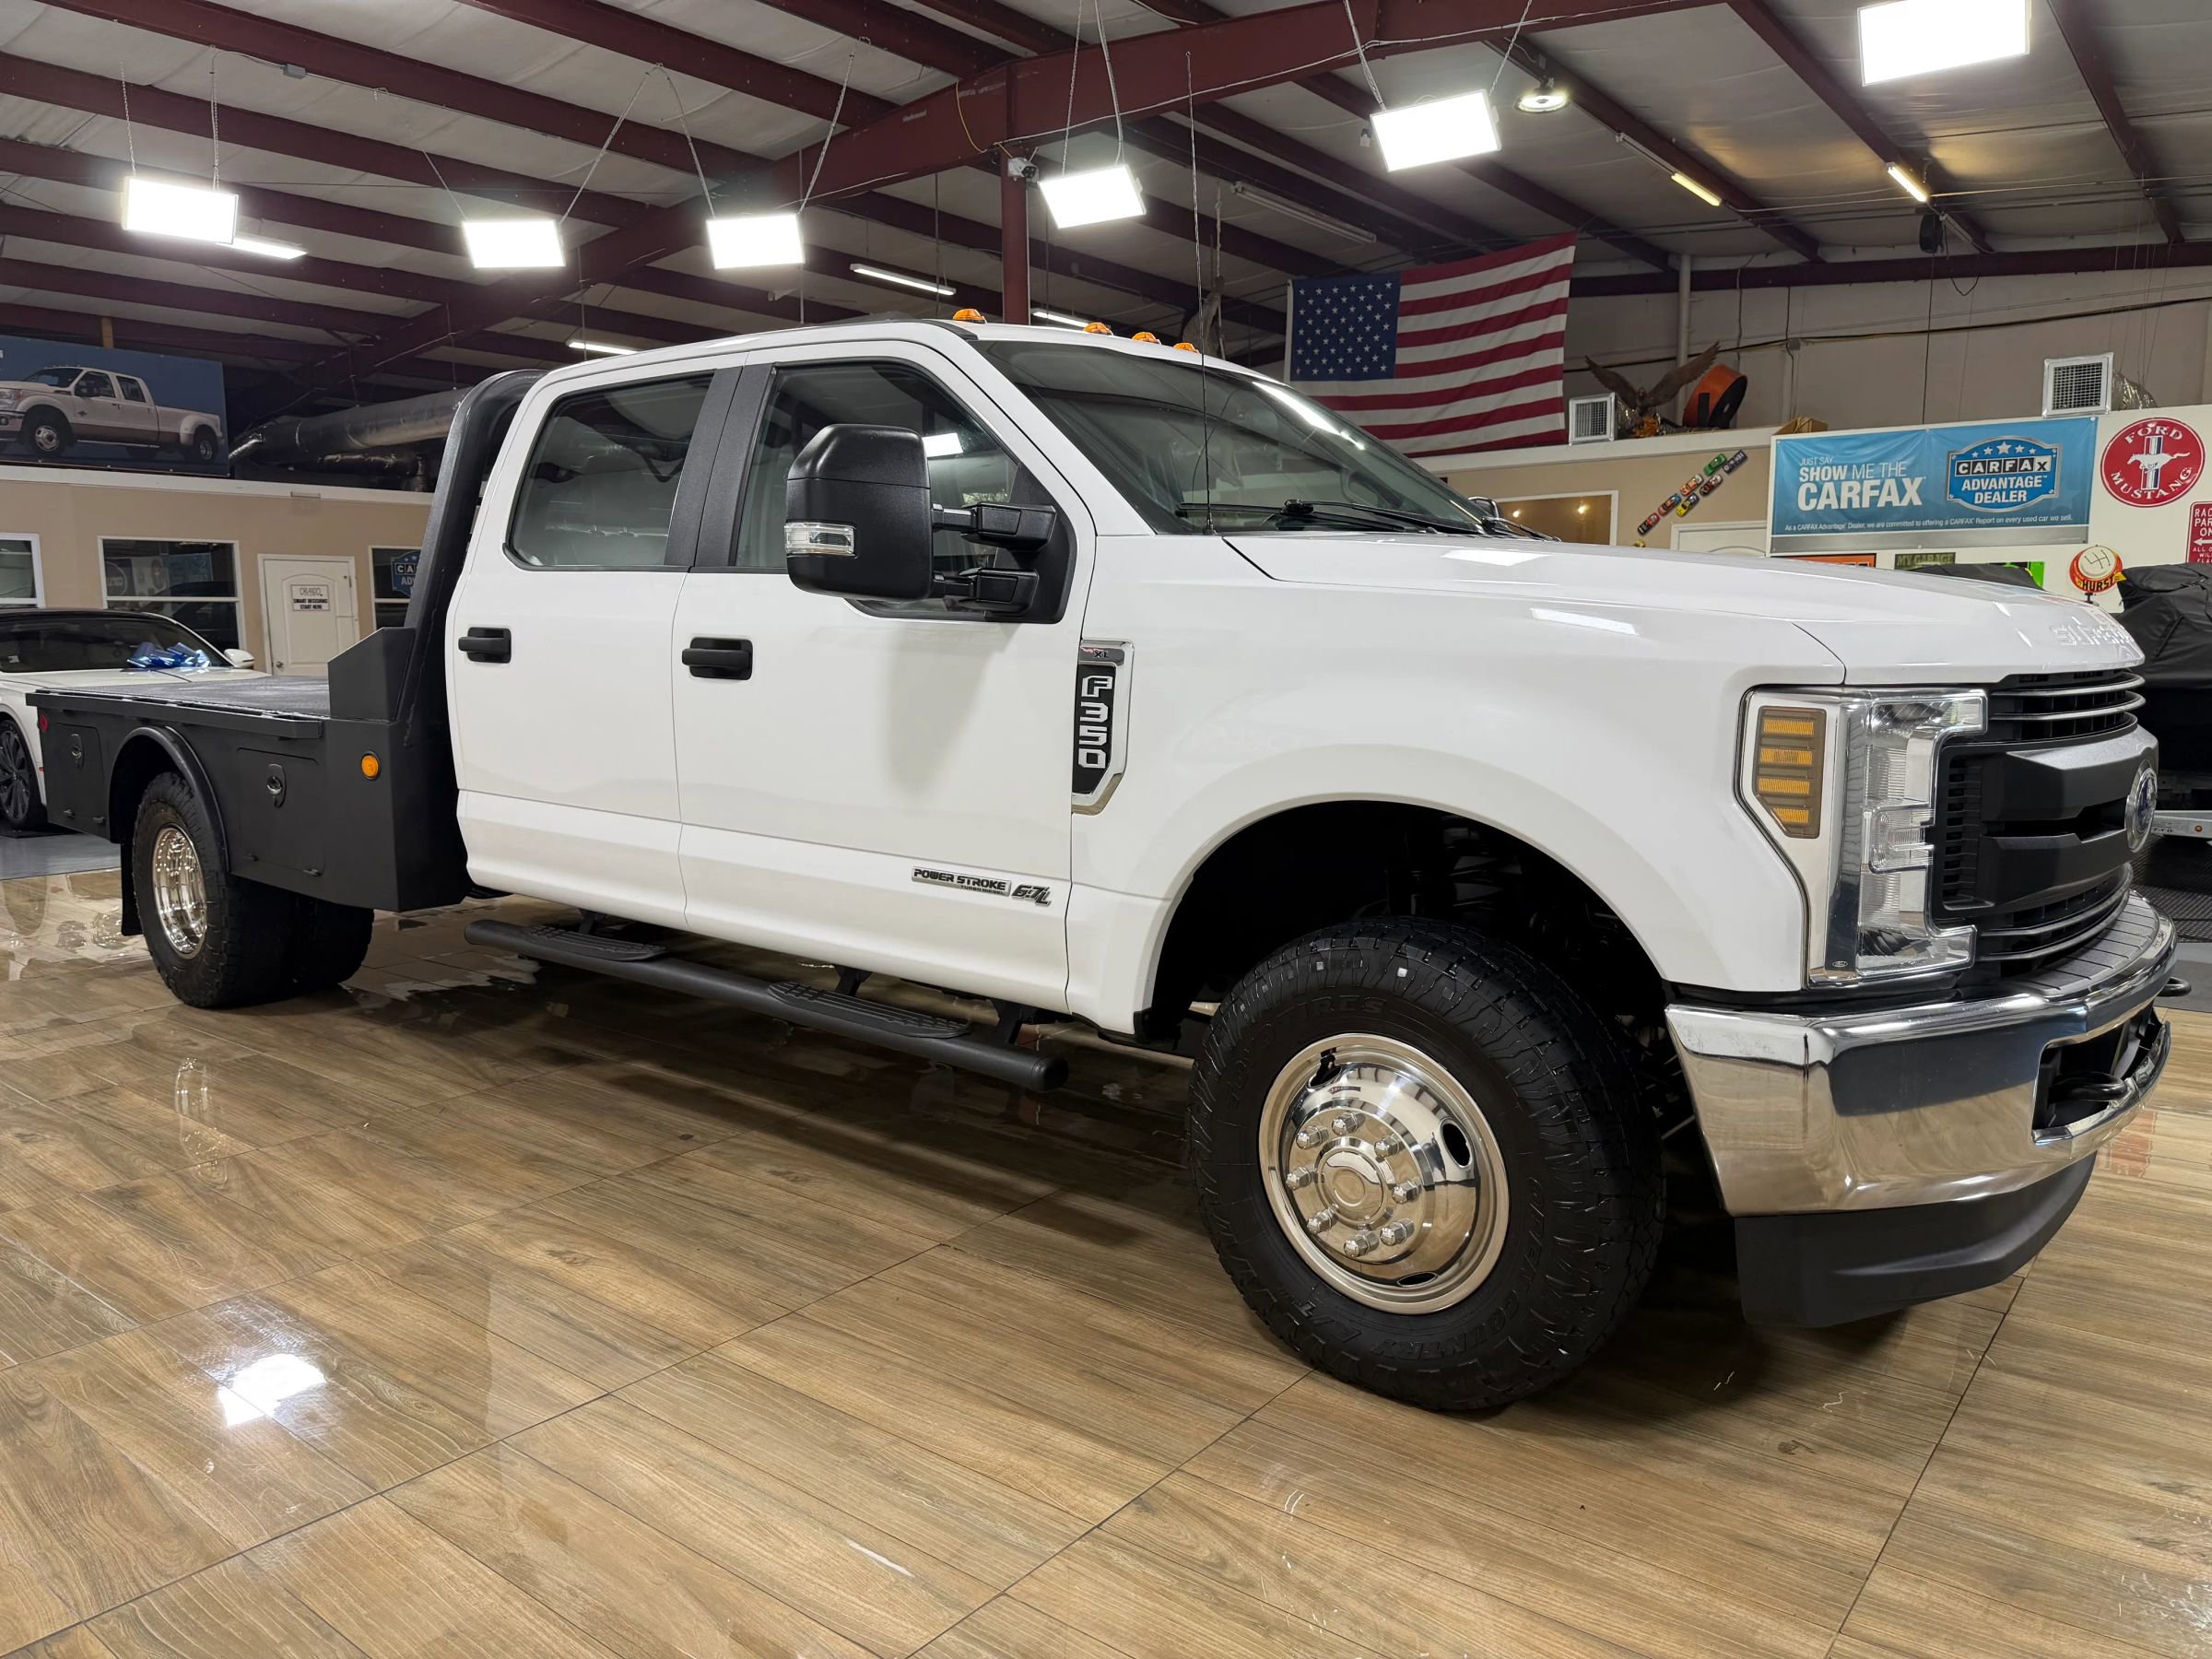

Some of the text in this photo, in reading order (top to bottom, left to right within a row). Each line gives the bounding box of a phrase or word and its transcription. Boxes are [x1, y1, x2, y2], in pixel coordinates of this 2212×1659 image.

[2124, 426, 2183, 443] FORD
[1799, 456, 1833, 465] JUST SAY
[1958, 459, 2048, 474] CARFAX
[1799, 461, 1907, 482] SHOW ME THE
[1961, 476, 2042, 491] ADVANTAGE
[2111, 466, 2193, 500] MUSTANG
[1797, 477, 1924, 511] CARFAX
[1974, 491, 2027, 504] DEALER
[1897, 554, 1953, 566] MY GARAGE
[2082, 576, 2114, 591] HURST
[1078, 675, 1113, 769] F350
[913, 868, 1006, 891] POWER STROKE
[1011, 884, 1052, 906] 6.7L
